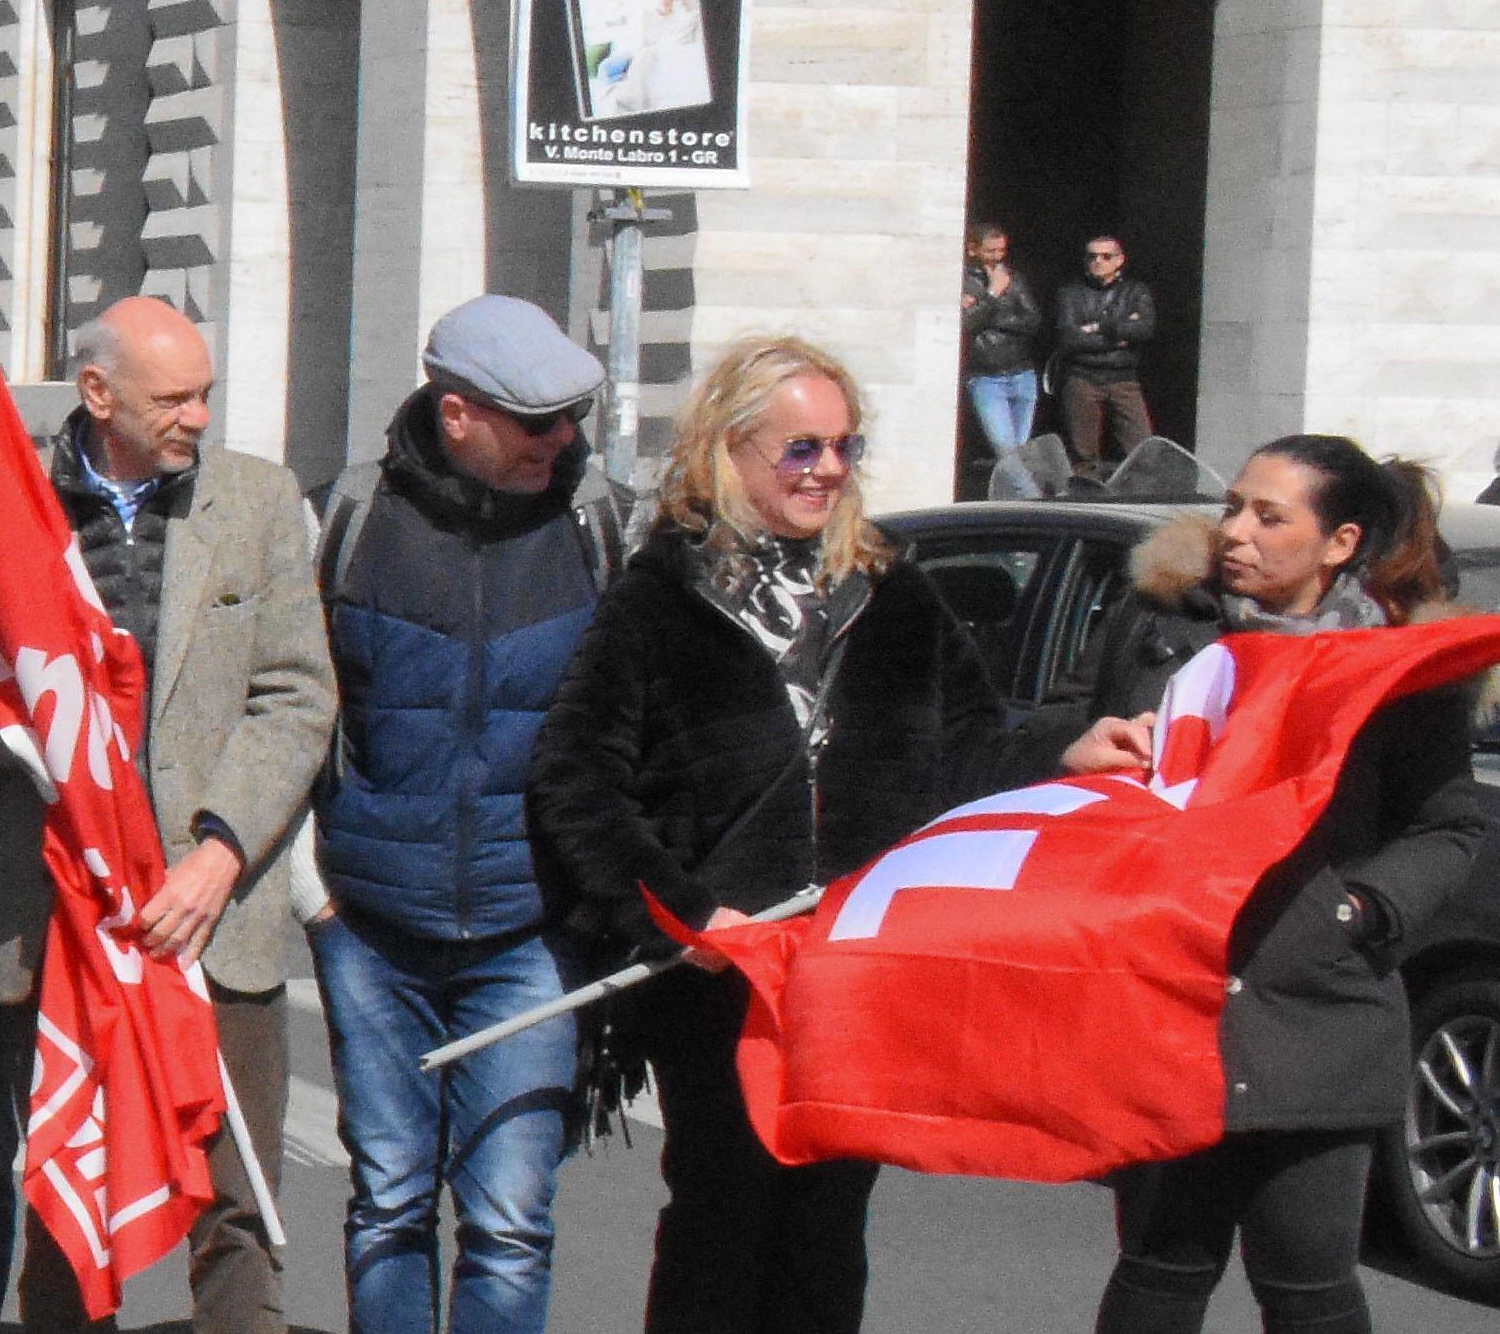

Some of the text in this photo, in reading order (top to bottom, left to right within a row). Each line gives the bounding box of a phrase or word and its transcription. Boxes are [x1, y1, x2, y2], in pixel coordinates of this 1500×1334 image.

[529, 122, 731, 147] kitchenstore
[544, 145, 560, 159] V.
[564, 146, 614, 161] Monte
[617, 148, 665, 163] Labro
[668, 150, 677, 164] 1
[691, 151, 719, 165] GR
